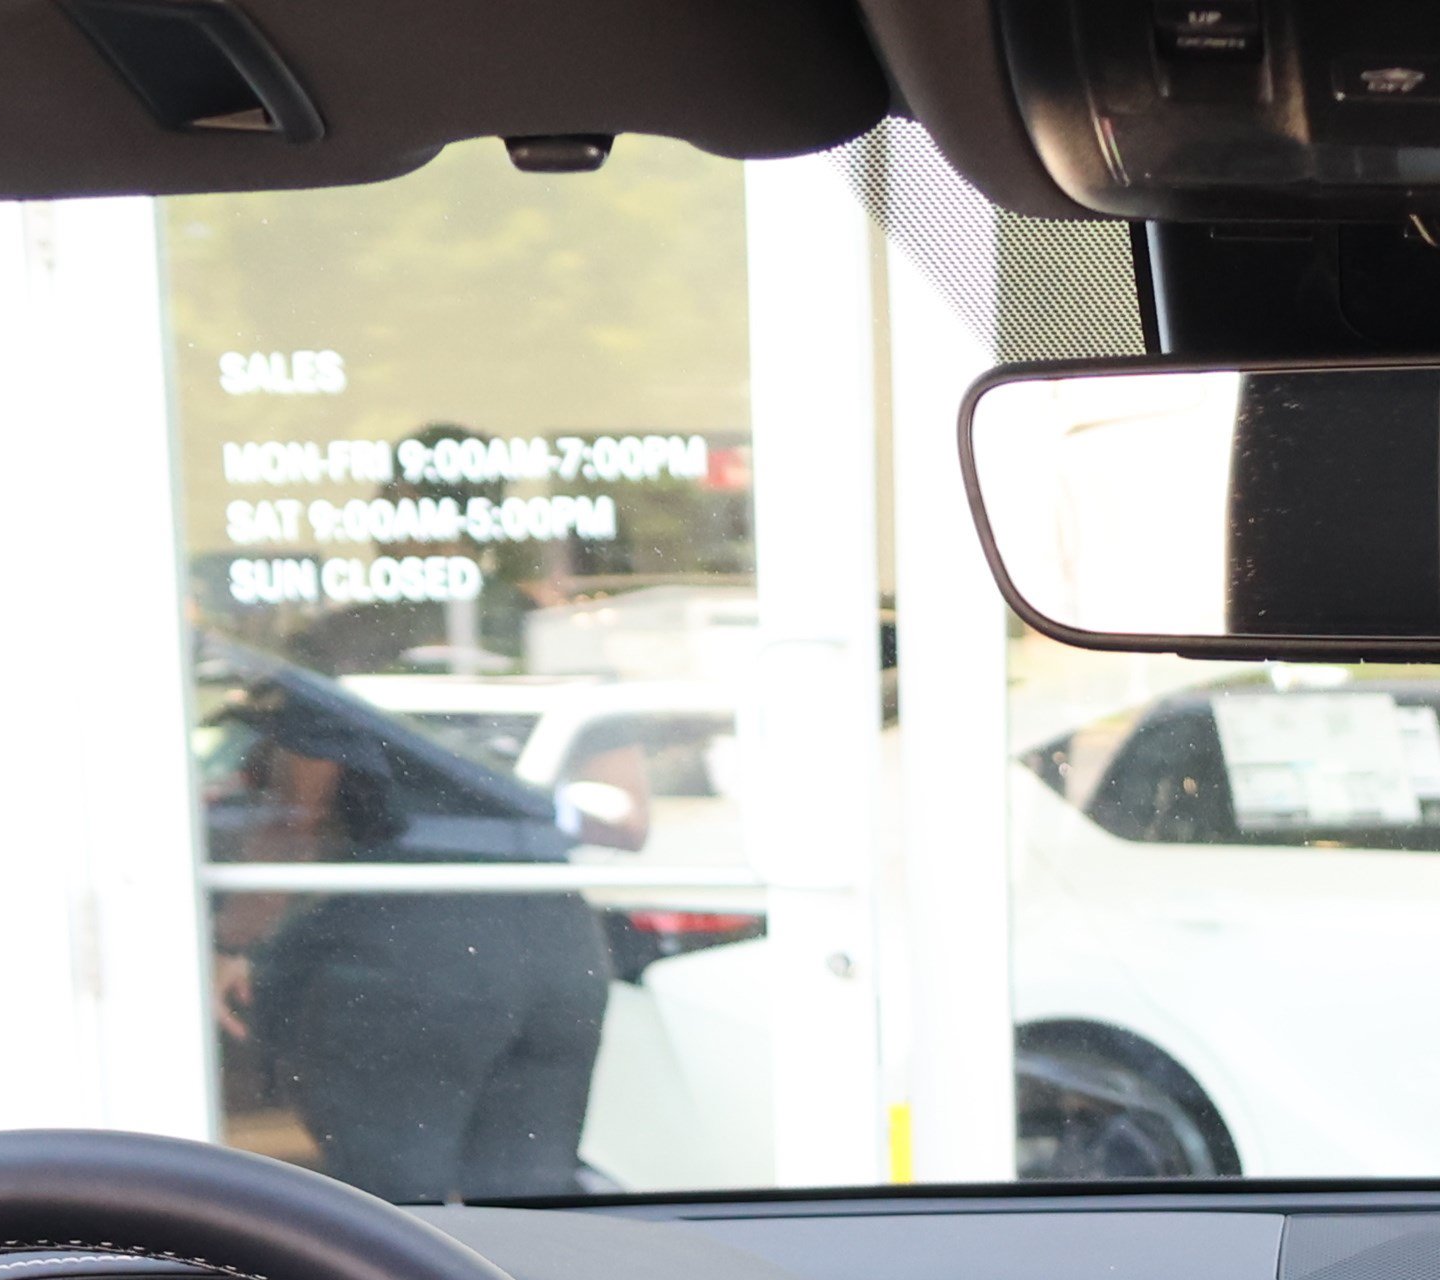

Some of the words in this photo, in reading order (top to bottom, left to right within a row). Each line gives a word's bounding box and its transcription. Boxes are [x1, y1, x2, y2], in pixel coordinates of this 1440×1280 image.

[220, 350, 347, 393] SALES
[223, 439, 393, 483] MON-FRI
[227, 499, 301, 542] SAT
[230, 558, 314, 602] SUN
[322, 556, 482, 600] CLOSED
